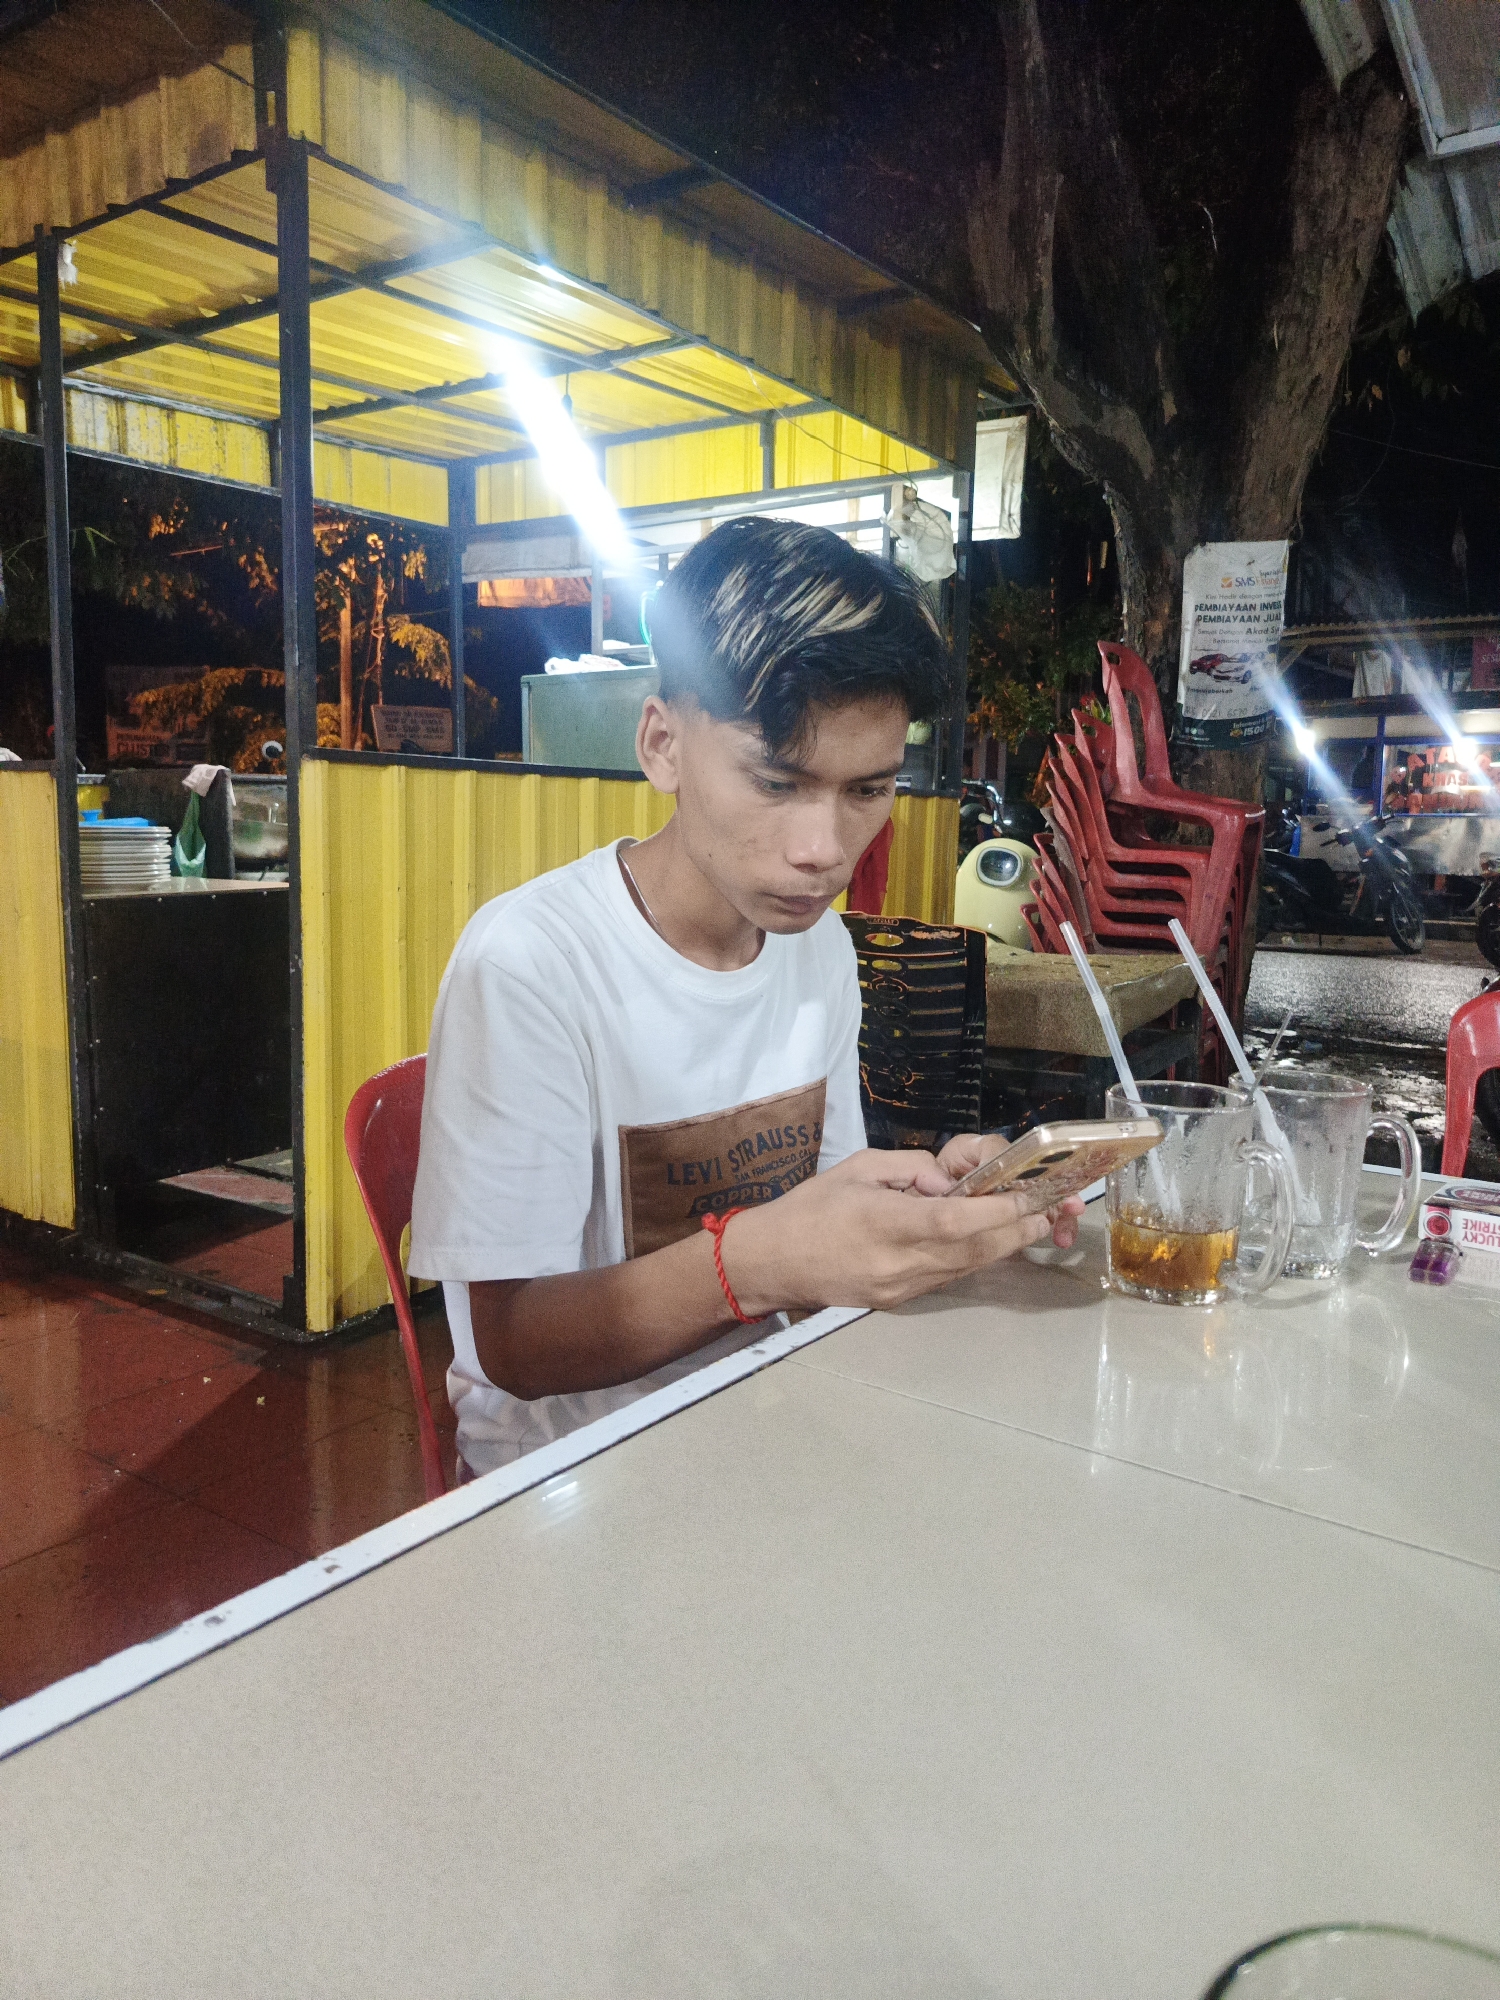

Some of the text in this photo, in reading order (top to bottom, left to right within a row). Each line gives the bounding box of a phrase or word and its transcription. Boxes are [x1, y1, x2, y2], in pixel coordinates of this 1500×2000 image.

[1235, 576, 1256, 587] SMS
[1194, 603, 1257, 613] PEMBIAYAAN
[1197, 614, 1261, 624] PEMBIAYAAN
[1245, 626, 1269, 635] Akad
[666, 1121, 822, 1186] LEVI STRAUSS &
[695, 1184, 773, 1212] COPPER
